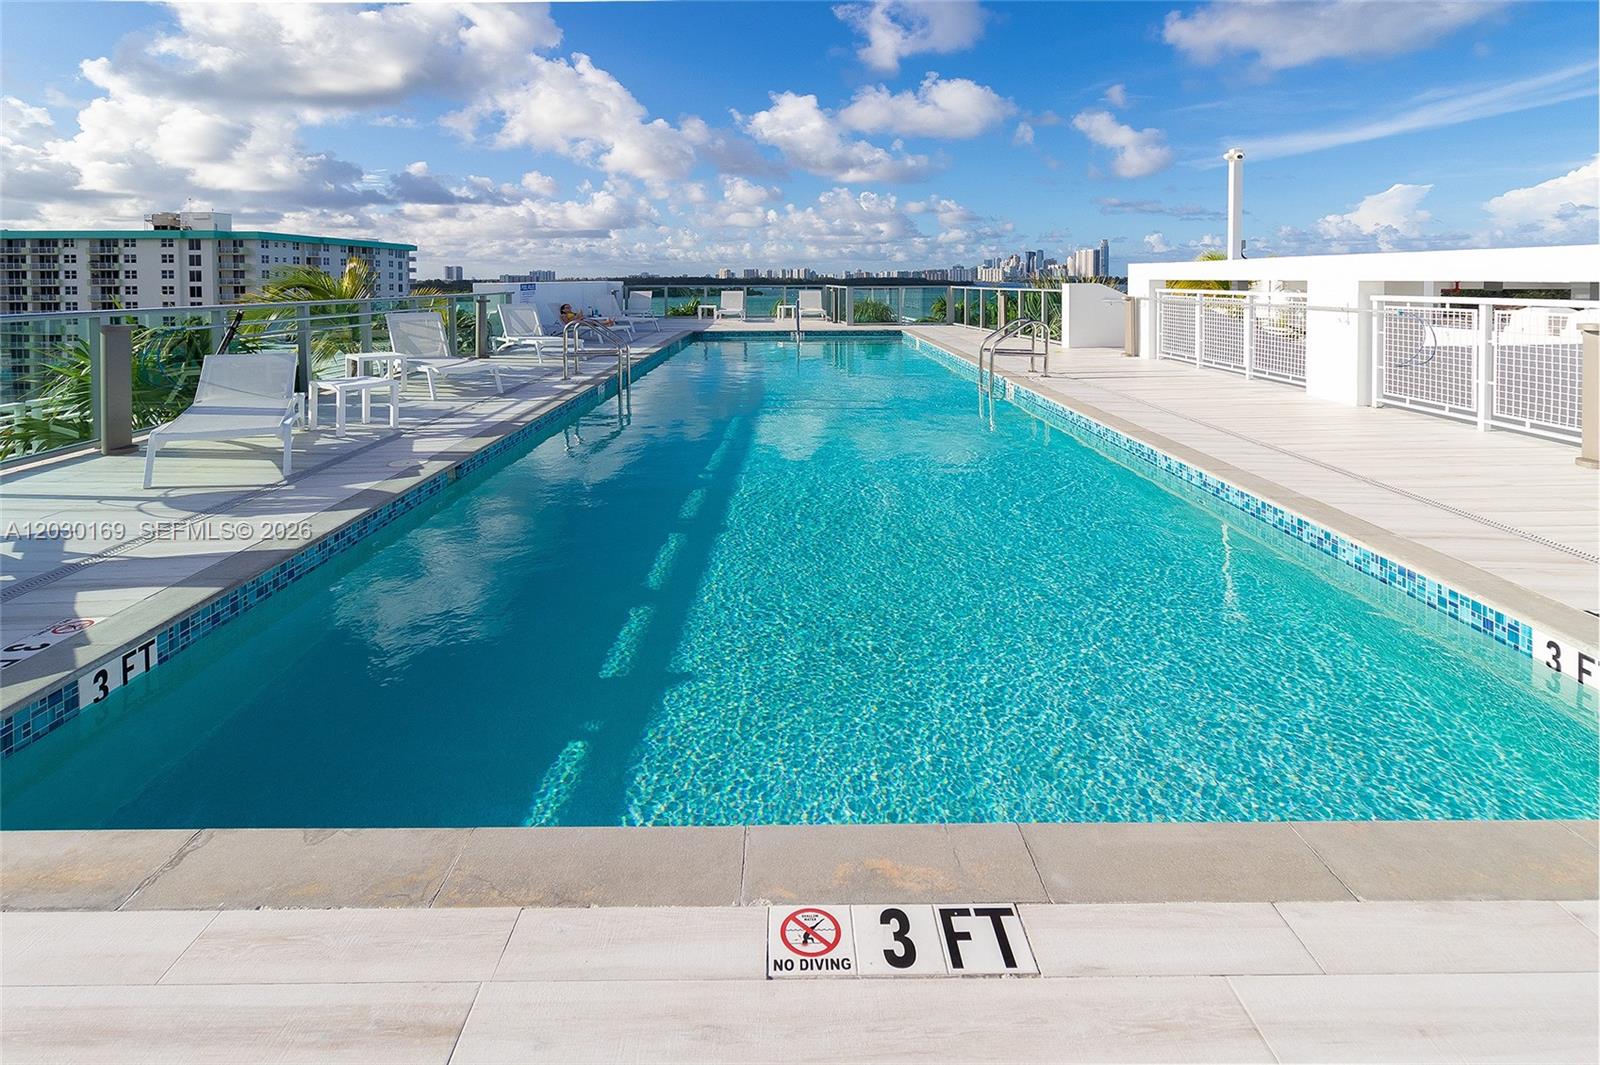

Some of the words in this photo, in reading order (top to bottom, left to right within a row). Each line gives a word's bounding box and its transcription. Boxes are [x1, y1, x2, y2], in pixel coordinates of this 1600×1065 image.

[93, 668, 109, 703] 3
[122, 638, 156, 687] FT
[1546, 640, 1562, 673] 3
[1577, 651, 1600, 685] F
[773, 958, 795, 971] NO
[799, 957, 852, 971] DIVING
[880, 908, 917, 969] 3
[938, 907, 1018, 969] FT
